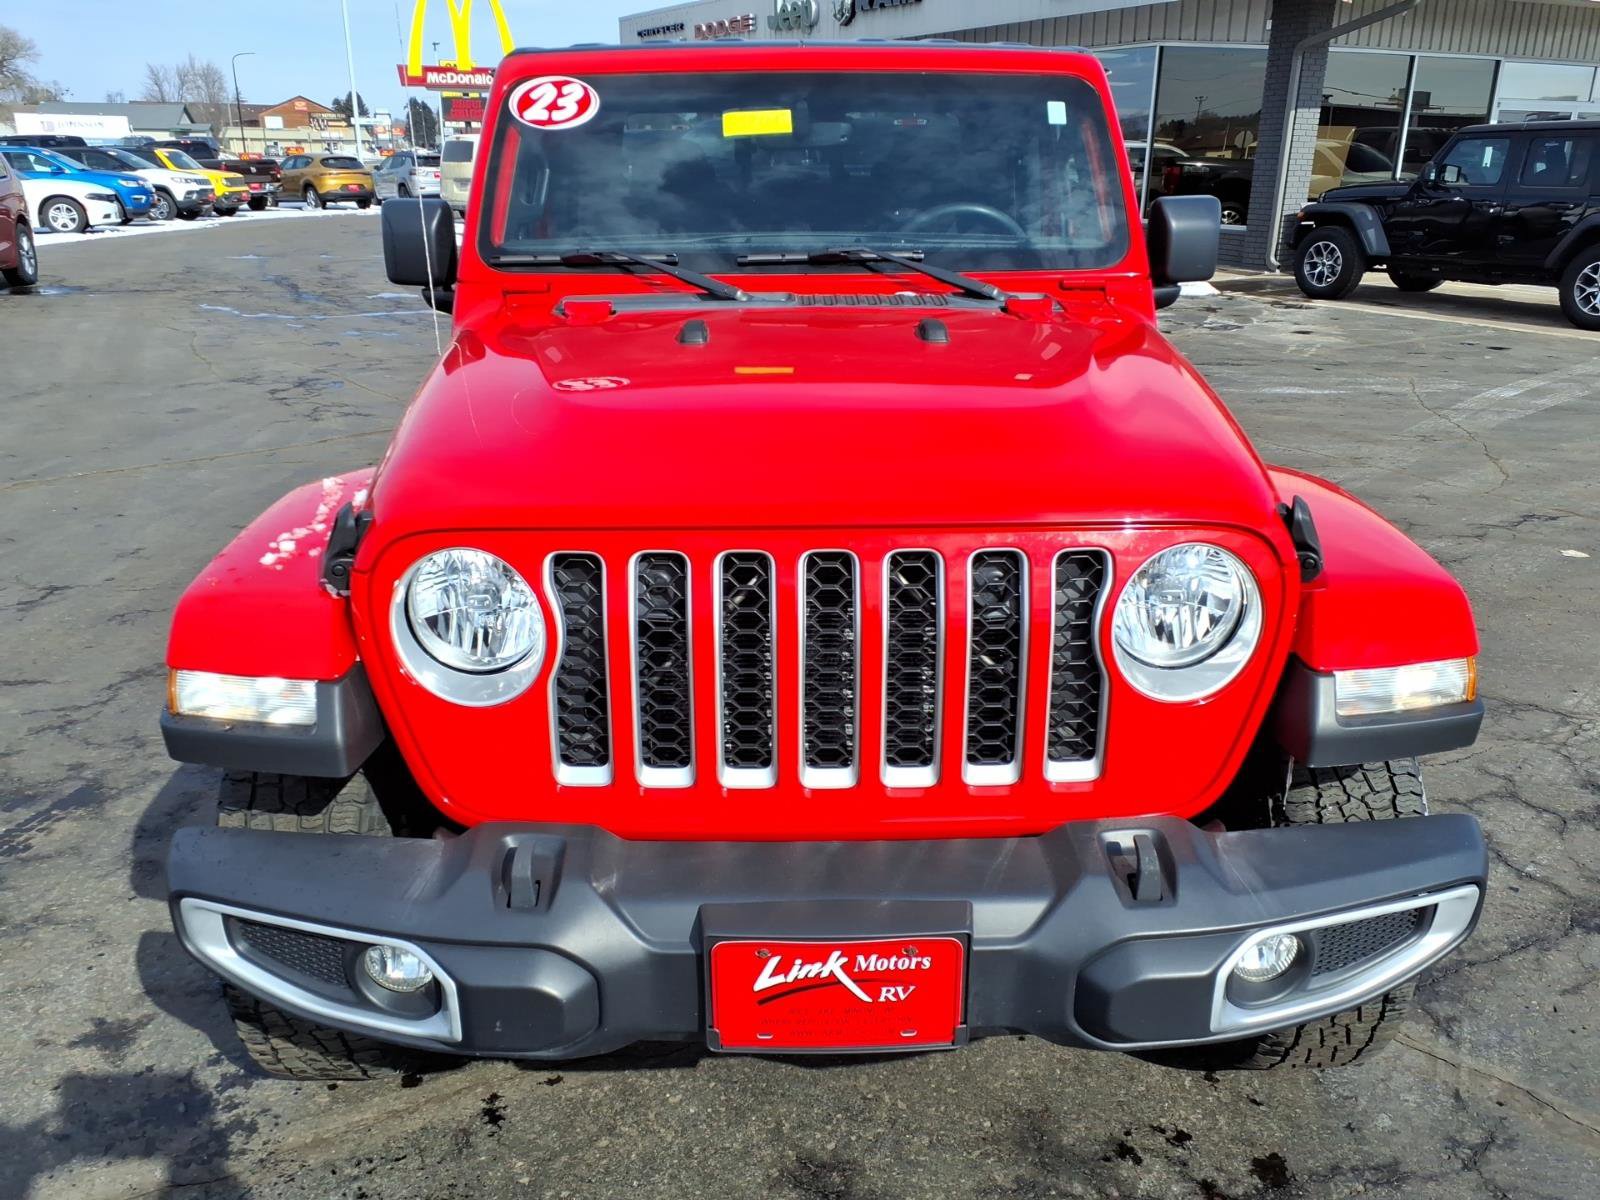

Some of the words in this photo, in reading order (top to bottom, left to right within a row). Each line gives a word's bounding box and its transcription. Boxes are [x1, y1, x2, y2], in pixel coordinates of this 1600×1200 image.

[694, 13, 757, 39] DODGE
[522, 81, 585, 122] 23
[753, 950, 873, 1003] Link
[853, 954, 931, 973] Motors
[878, 985, 916, 1002] RV
